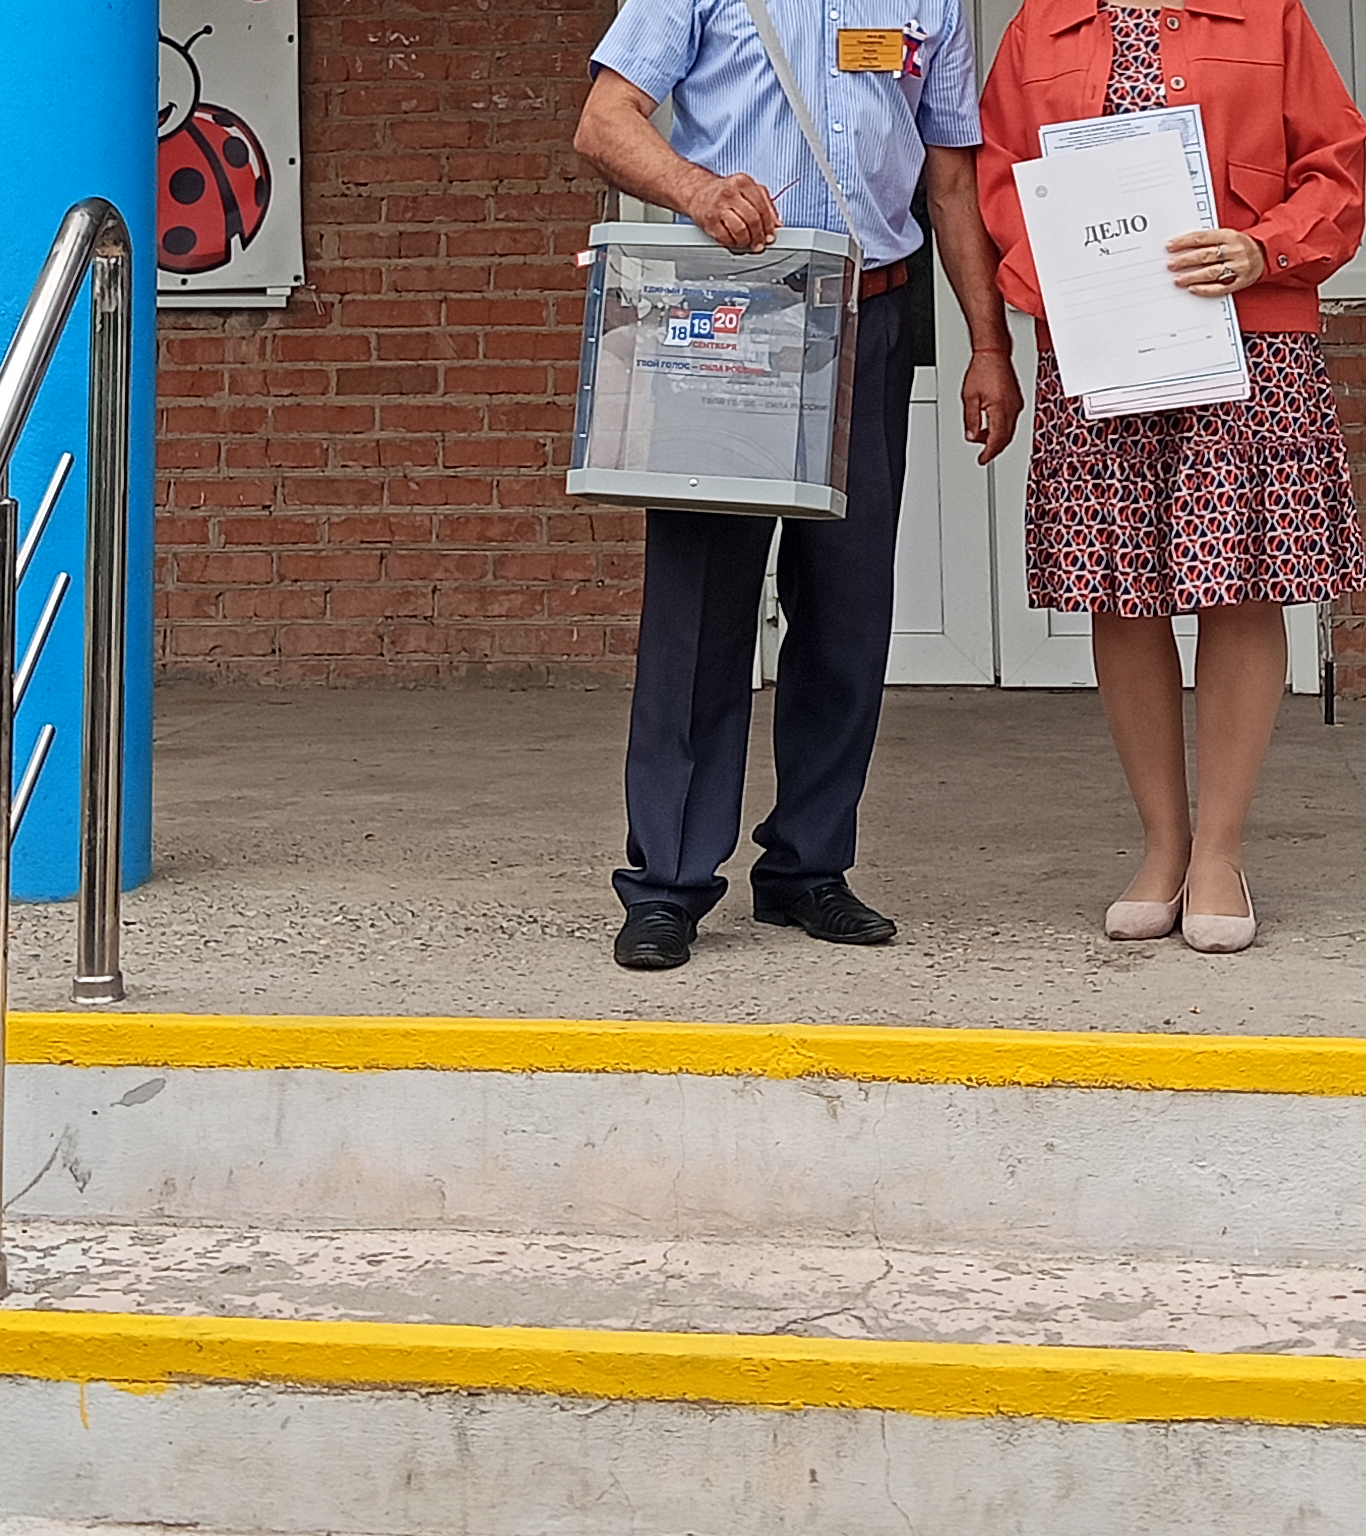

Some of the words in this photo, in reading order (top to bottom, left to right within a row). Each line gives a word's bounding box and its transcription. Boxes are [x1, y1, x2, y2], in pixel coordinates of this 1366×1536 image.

[1084, 214, 1148, 247] ДЕЛО
[692, 317, 711, 335] 19
[714, 313, 737, 329] 20
[670, 325, 688, 341] 18
[692, 341, 738, 352] СЕНТЯБРЯ
[636, 359, 660, 368] ТВОЙ
[660, 360, 691, 370] ГОЛОС
